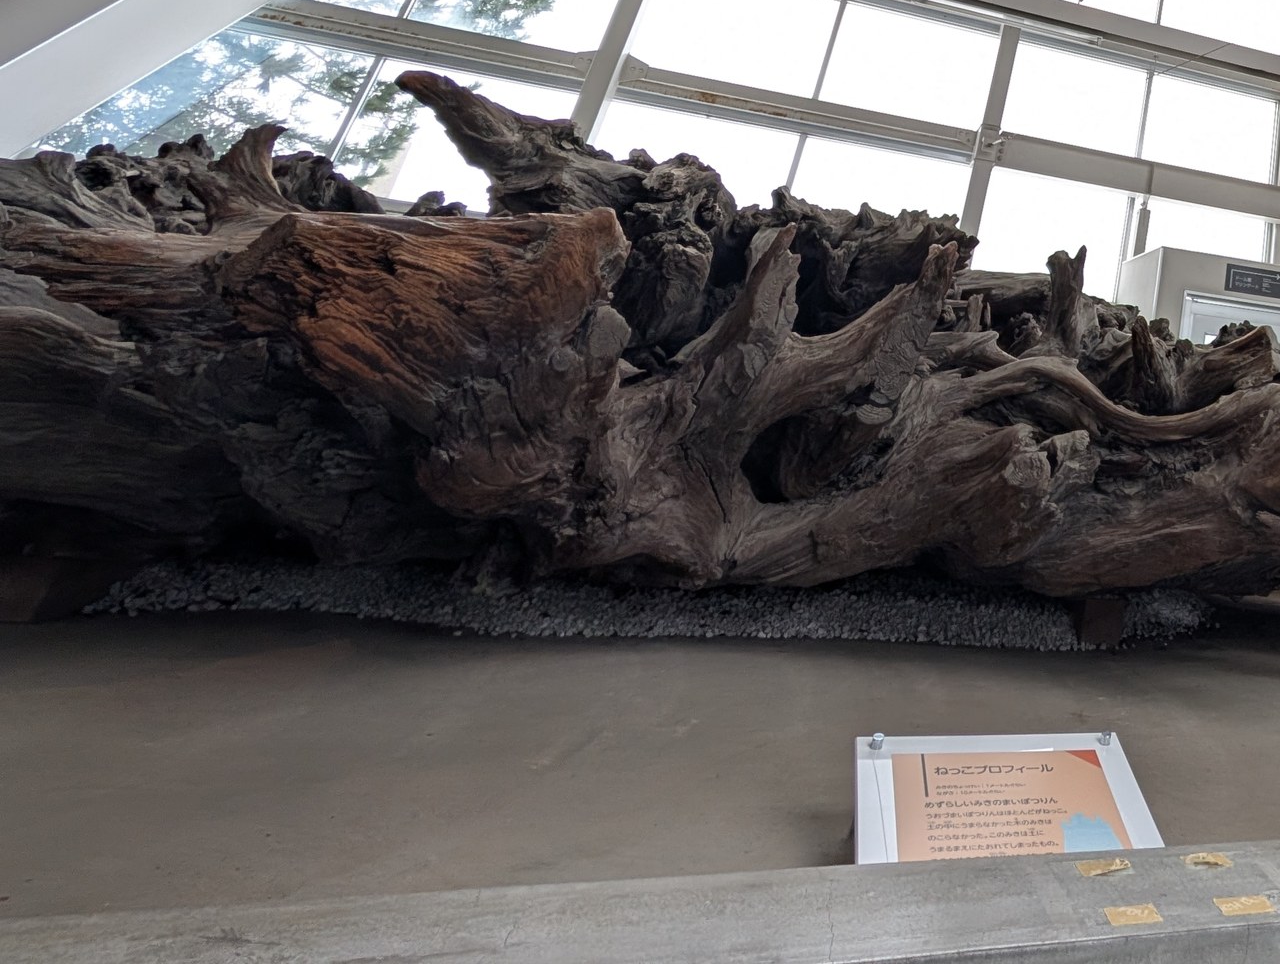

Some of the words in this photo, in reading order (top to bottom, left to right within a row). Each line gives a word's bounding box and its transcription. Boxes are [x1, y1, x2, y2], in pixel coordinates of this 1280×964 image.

[934, 763, 1054, 776] ねっこプロフィール
[924, 797, 1058, 809] めずらしいみきのまいぼつりん
